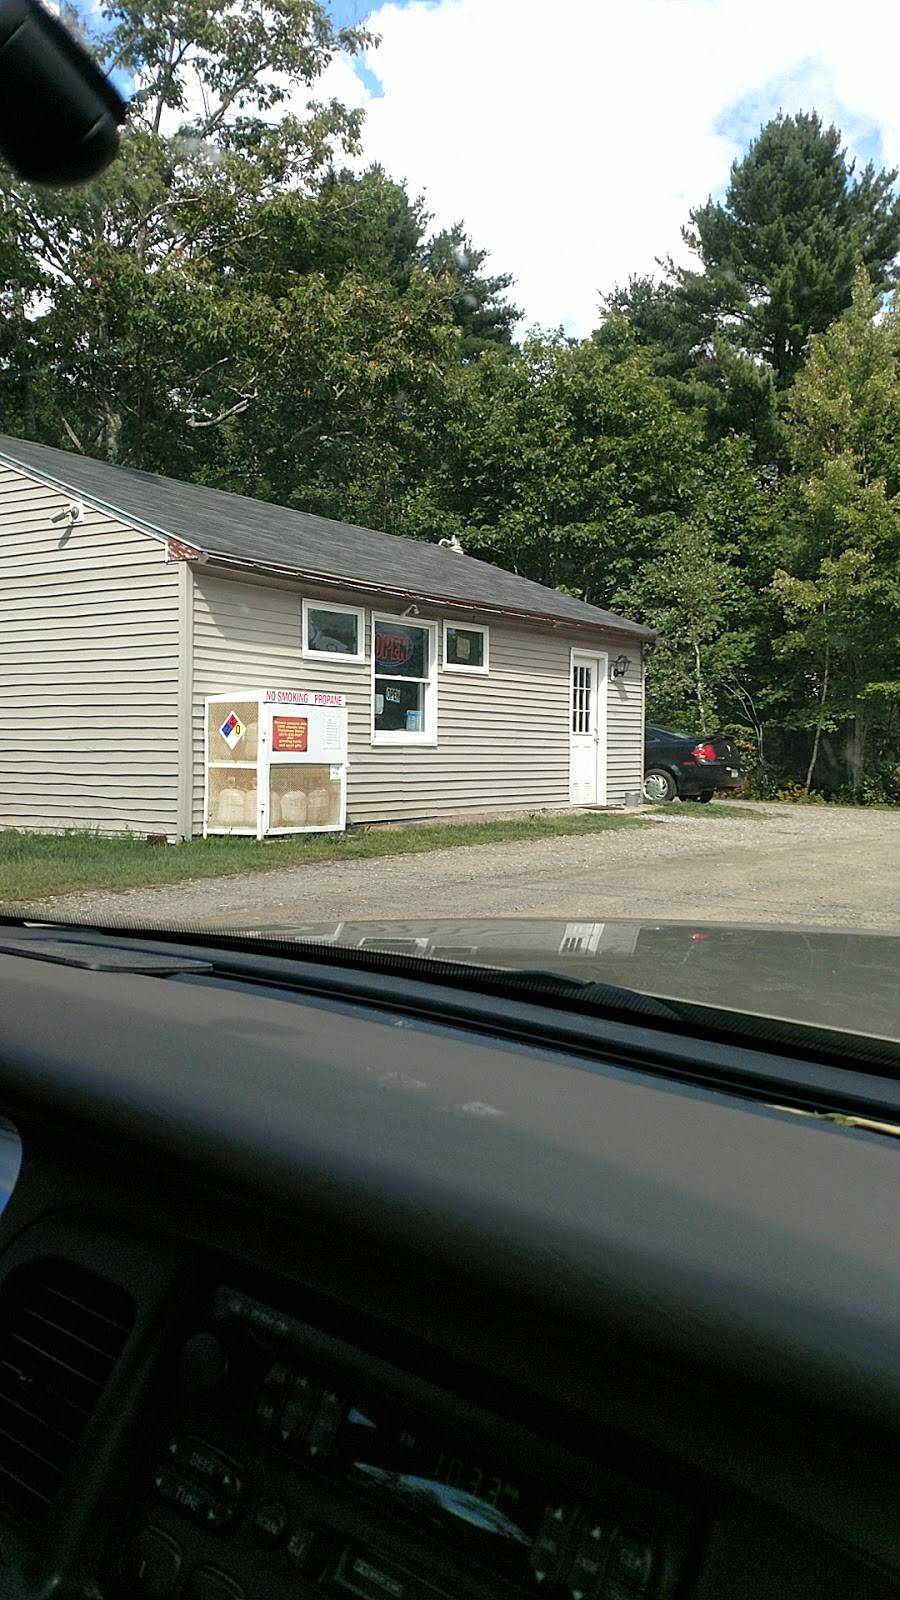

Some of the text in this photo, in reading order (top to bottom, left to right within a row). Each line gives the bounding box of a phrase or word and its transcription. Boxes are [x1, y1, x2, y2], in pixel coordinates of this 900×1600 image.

[375, 634, 409, 661] OPEN
[265, 690, 343, 706] NO SMOKING PROPANE
[386, 688, 400, 701] OPEN
